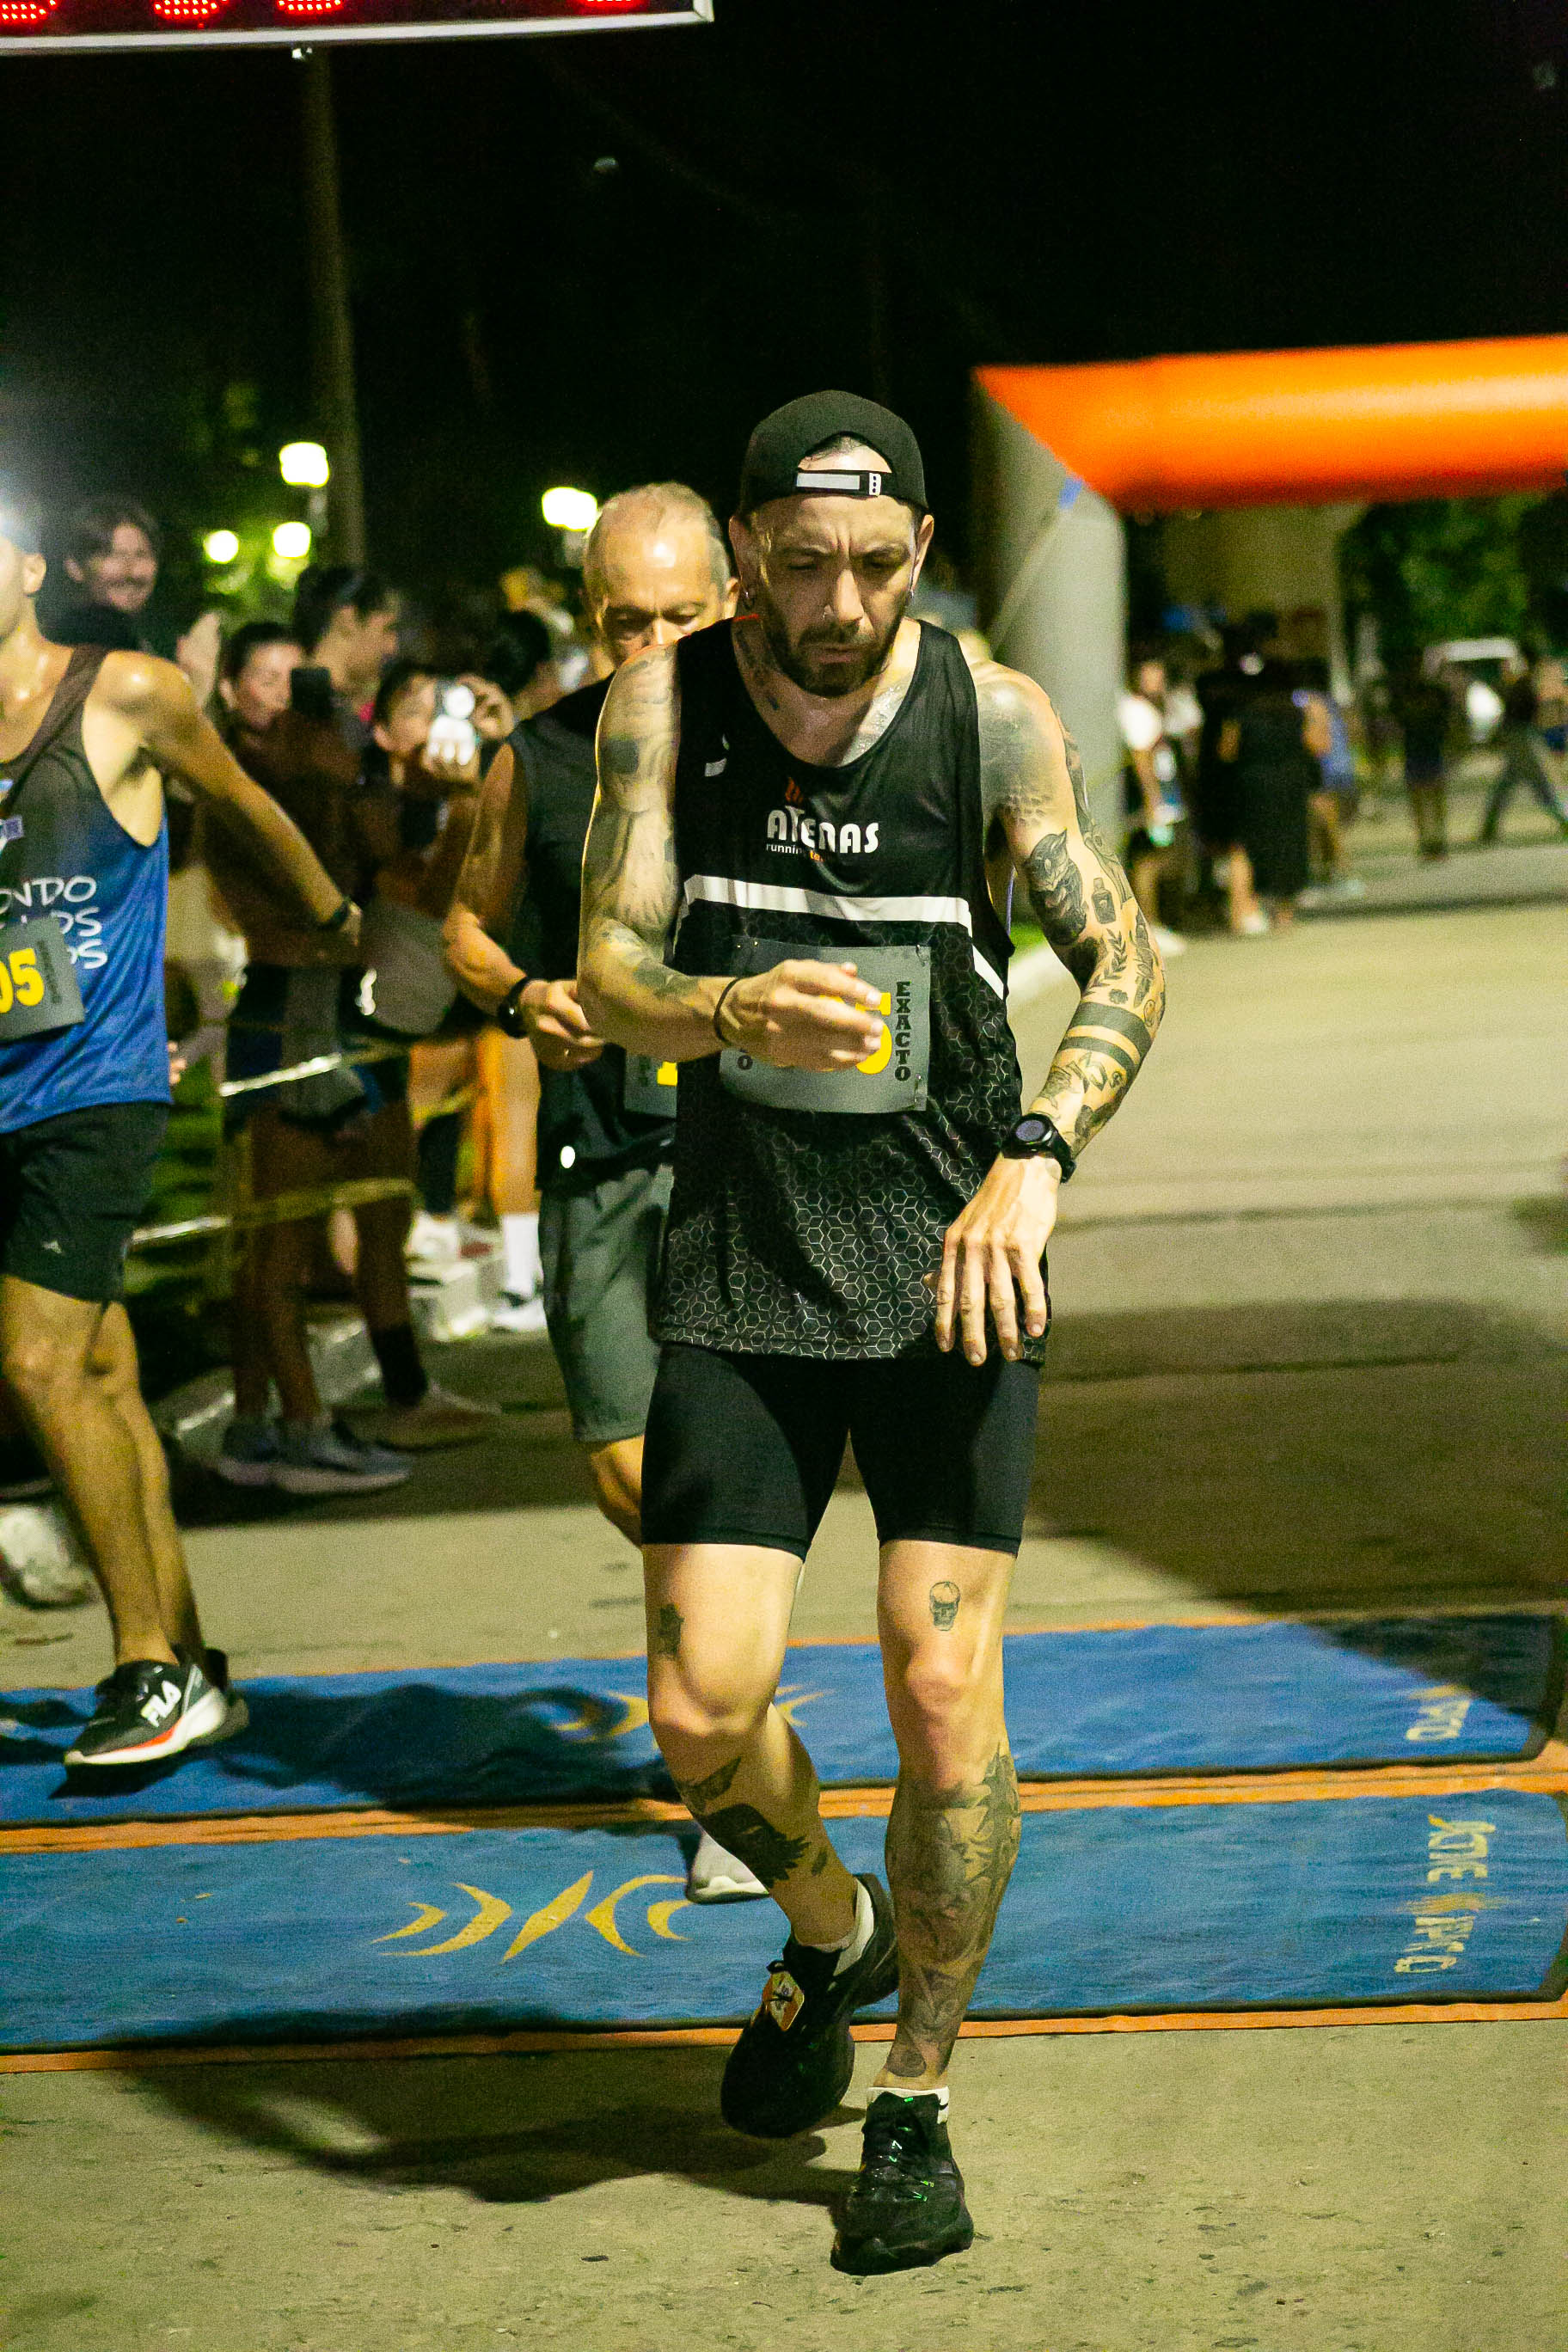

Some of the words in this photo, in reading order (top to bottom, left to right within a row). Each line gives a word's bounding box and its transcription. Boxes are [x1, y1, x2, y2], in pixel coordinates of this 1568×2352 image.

[766, 843, 806, 855] runnin
[767, 805, 879, 854] ATENAS
[895, 981, 911, 1081] EXACTO
